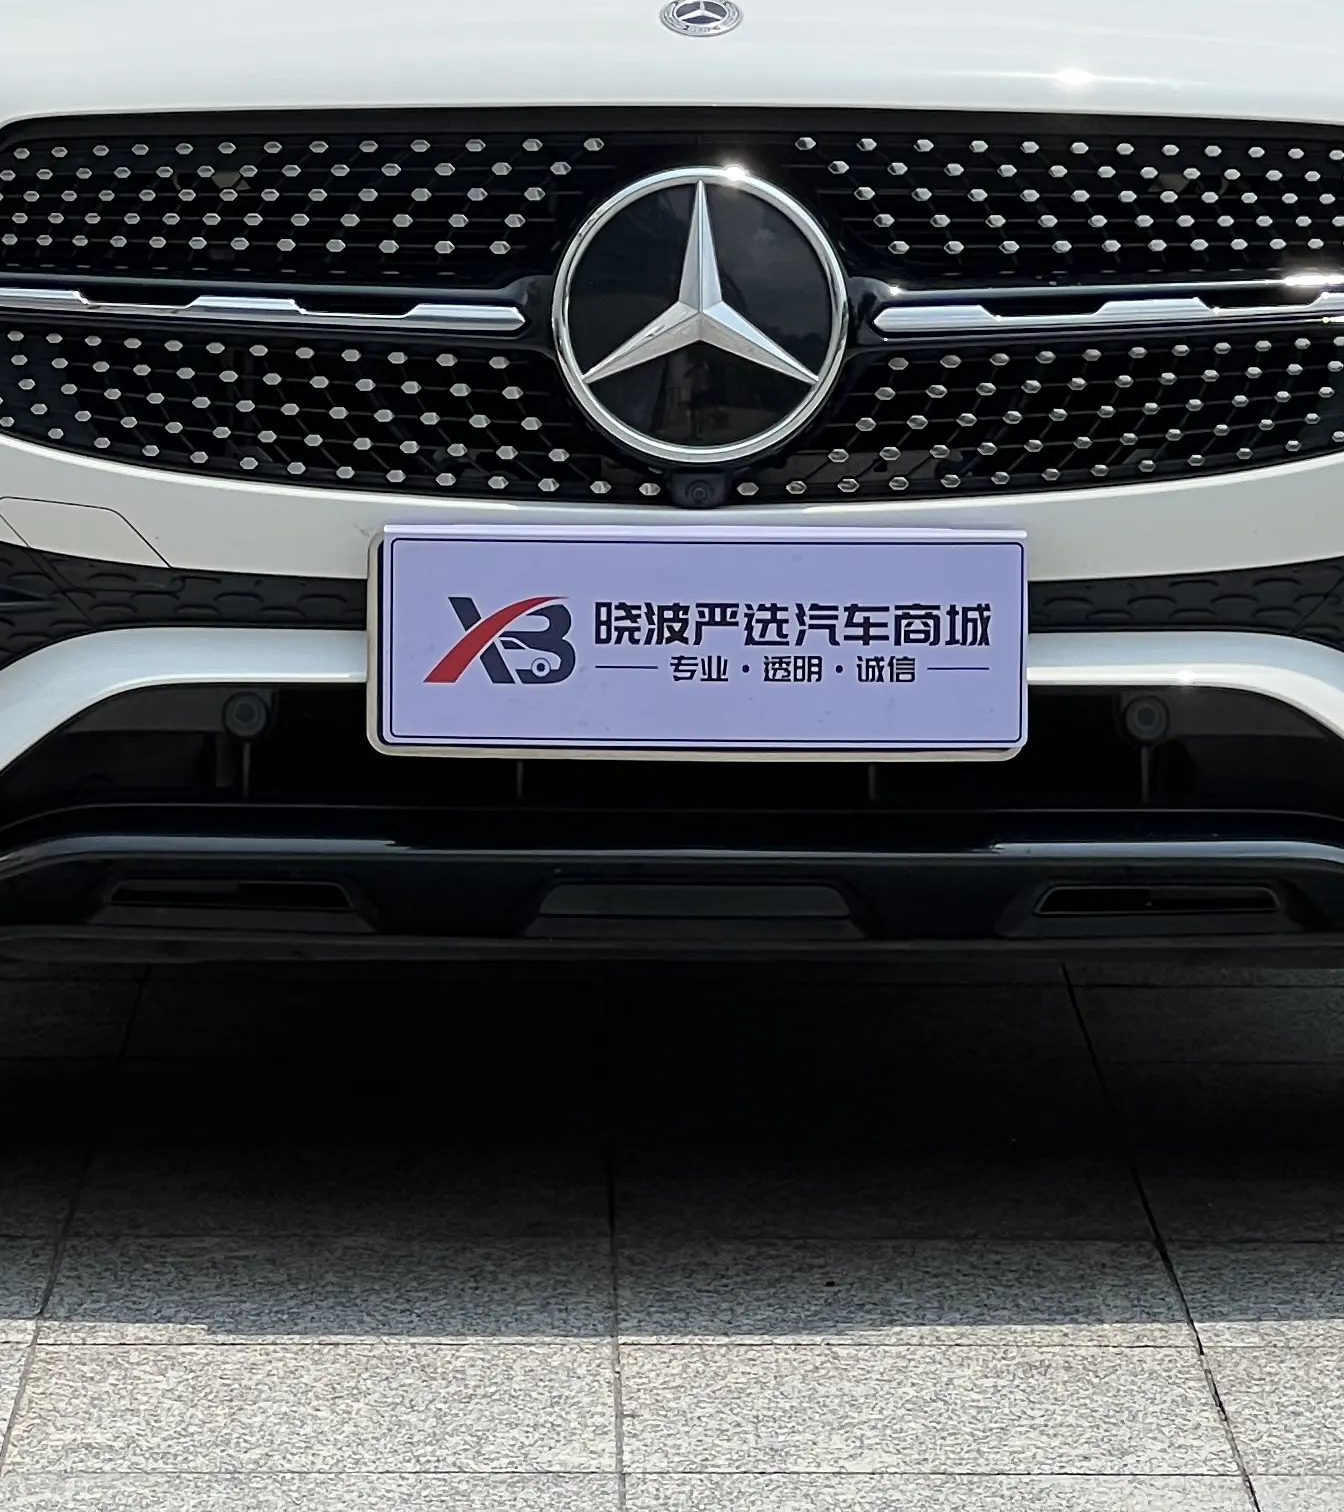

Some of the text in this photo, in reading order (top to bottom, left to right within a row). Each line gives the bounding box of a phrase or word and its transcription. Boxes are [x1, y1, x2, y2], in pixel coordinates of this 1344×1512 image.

[594, 600, 992, 647] 晓波严选汽车商城
